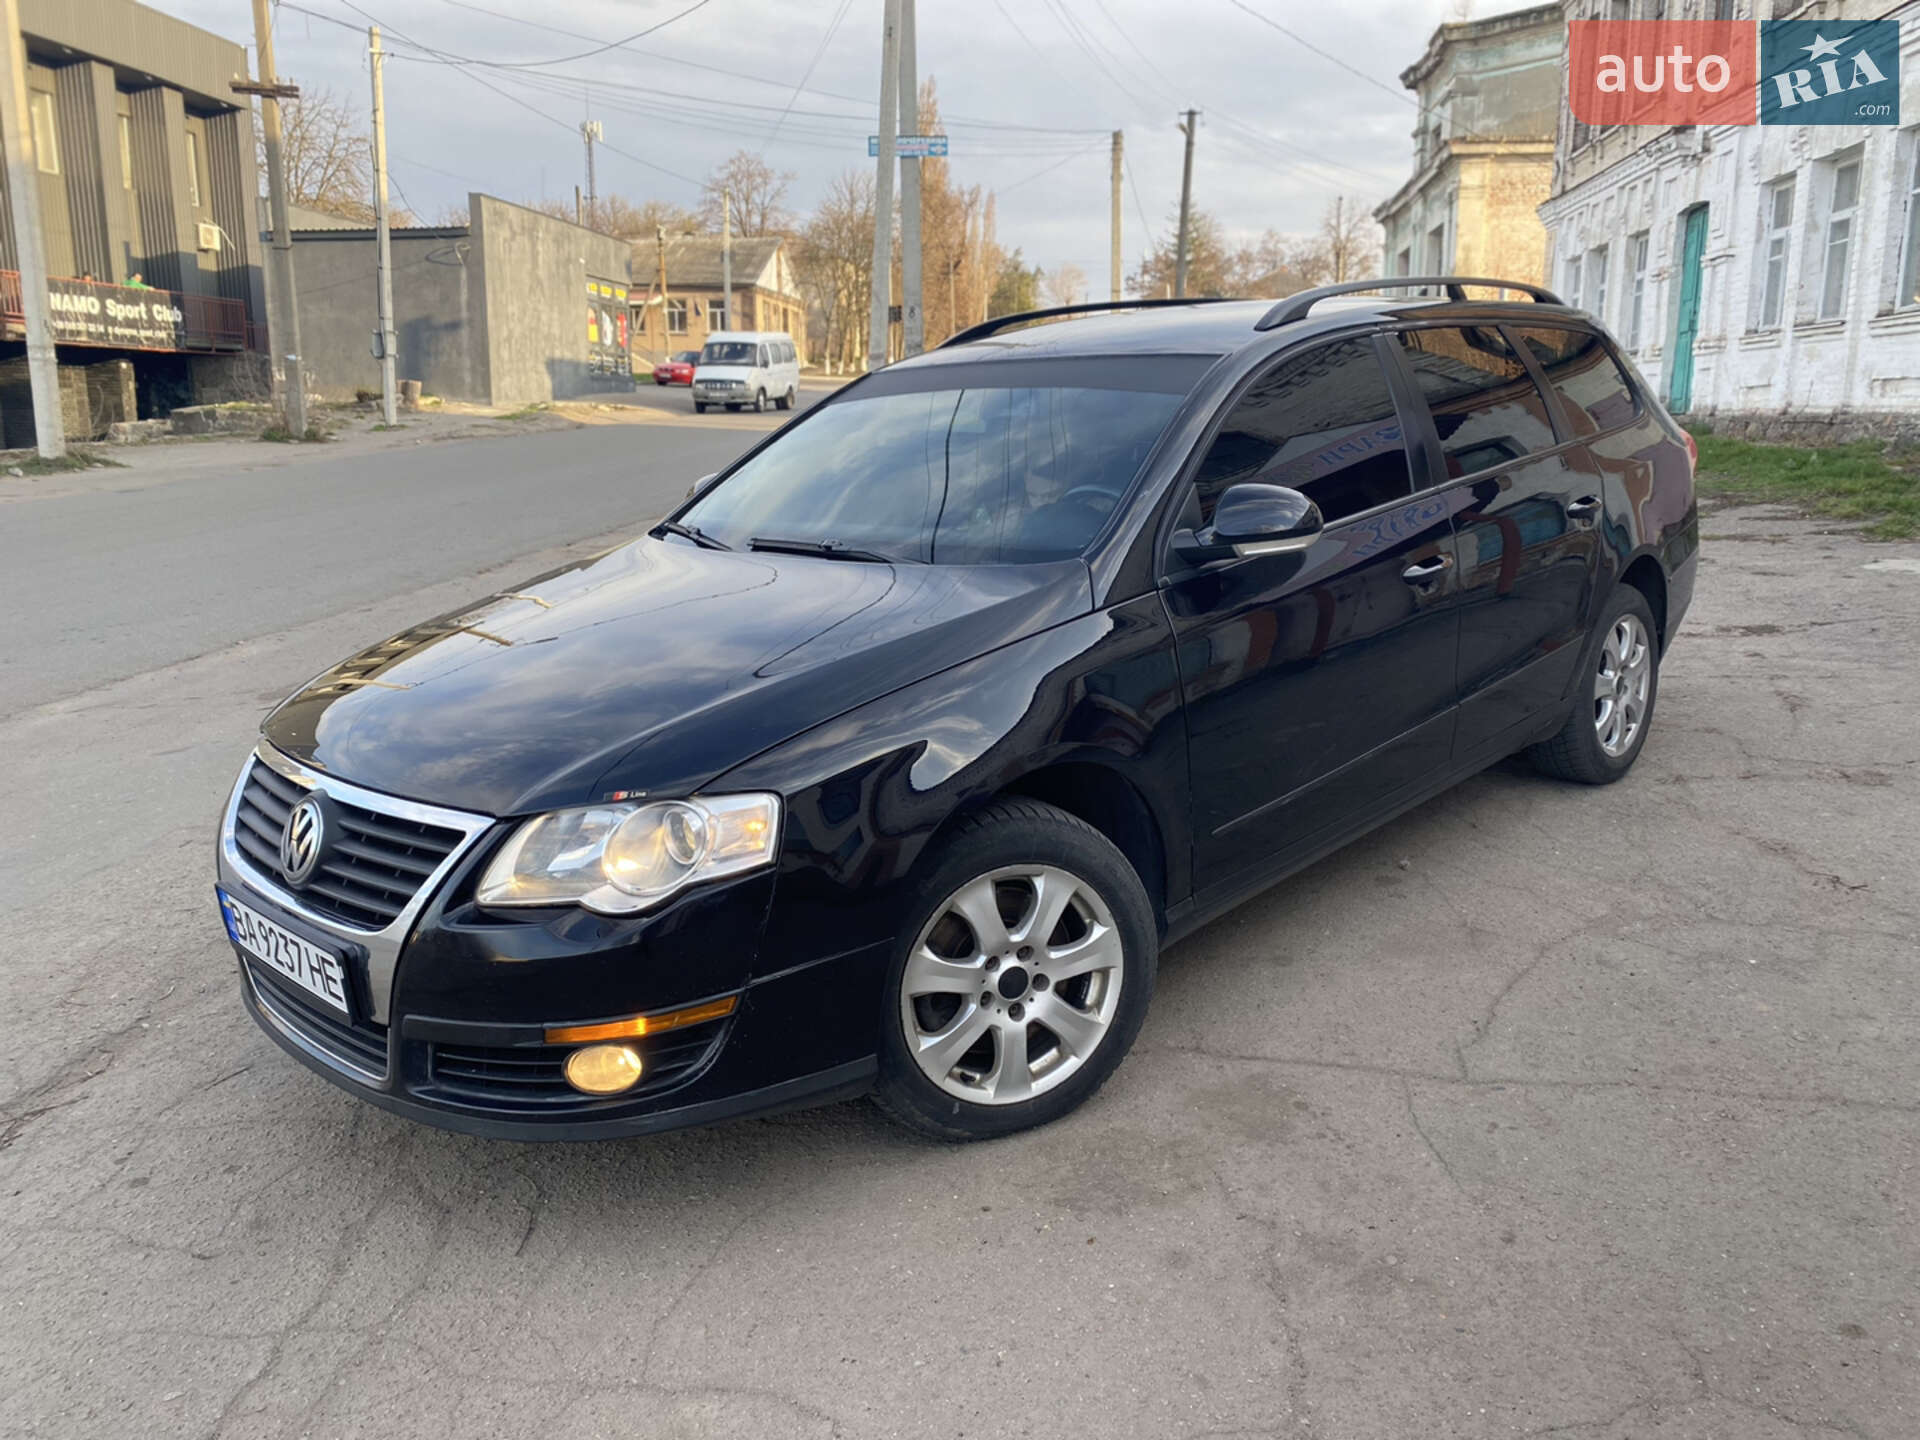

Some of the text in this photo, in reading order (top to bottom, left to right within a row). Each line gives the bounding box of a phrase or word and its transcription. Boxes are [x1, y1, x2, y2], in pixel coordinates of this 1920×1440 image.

[50, 292, 183, 322] NAMO Sport Club
